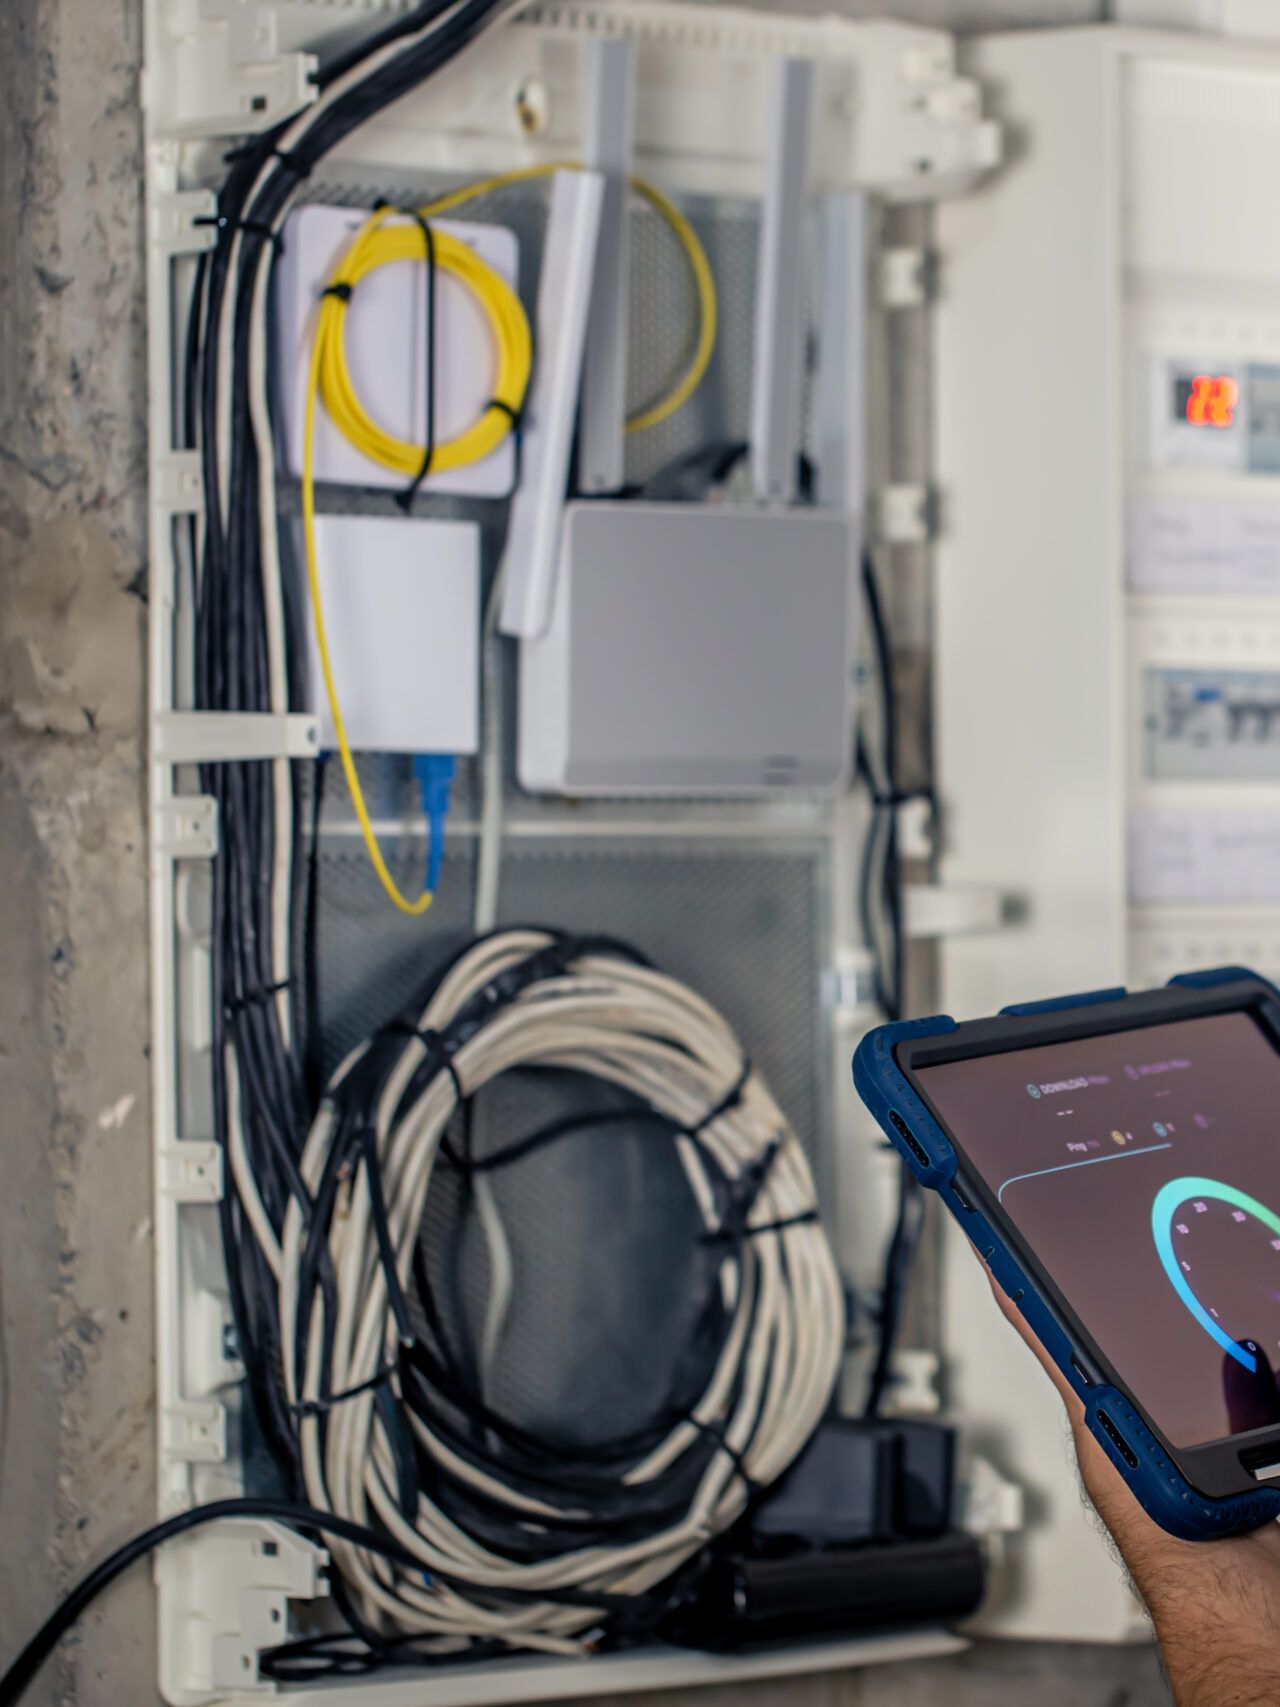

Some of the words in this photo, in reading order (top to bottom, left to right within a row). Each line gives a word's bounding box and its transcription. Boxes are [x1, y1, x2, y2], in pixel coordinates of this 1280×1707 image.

[1040, 1077, 1088, 1094] DOWNLOAD
[1066, 1142, 1088, 1152] Ping
[1193, 1201, 1208, 1213] 20
[1176, 1223, 1190, 1234] 10
[1181, 1260, 1191, 1272] 5
[1247, 1342, 1257, 1352] 0
